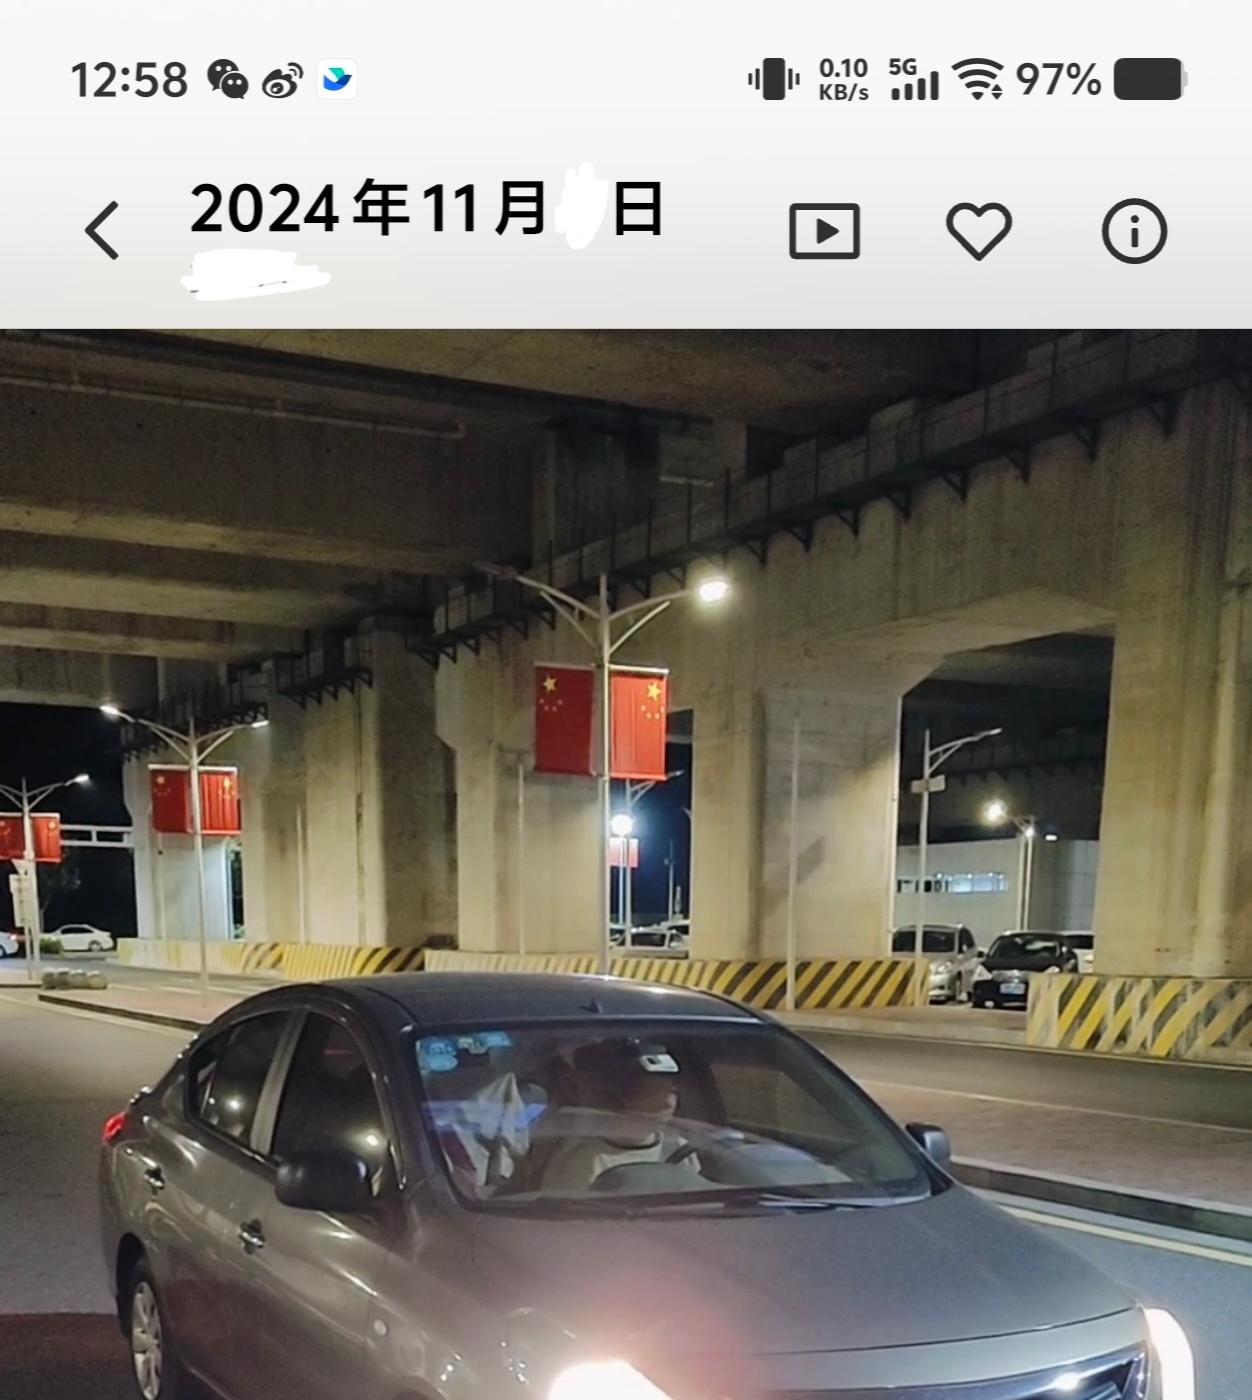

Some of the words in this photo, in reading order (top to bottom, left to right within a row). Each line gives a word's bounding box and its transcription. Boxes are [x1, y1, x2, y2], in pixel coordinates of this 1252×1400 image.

[71, 61, 188, 98] 12:58
[819, 57, 868, 78] 0.10
[888, 57, 917, 76] 5G
[1016, 62, 1102, 96] 97%
[819, 83, 869, 102] KB/s
[190, 178, 661, 236] 2024年11月日
